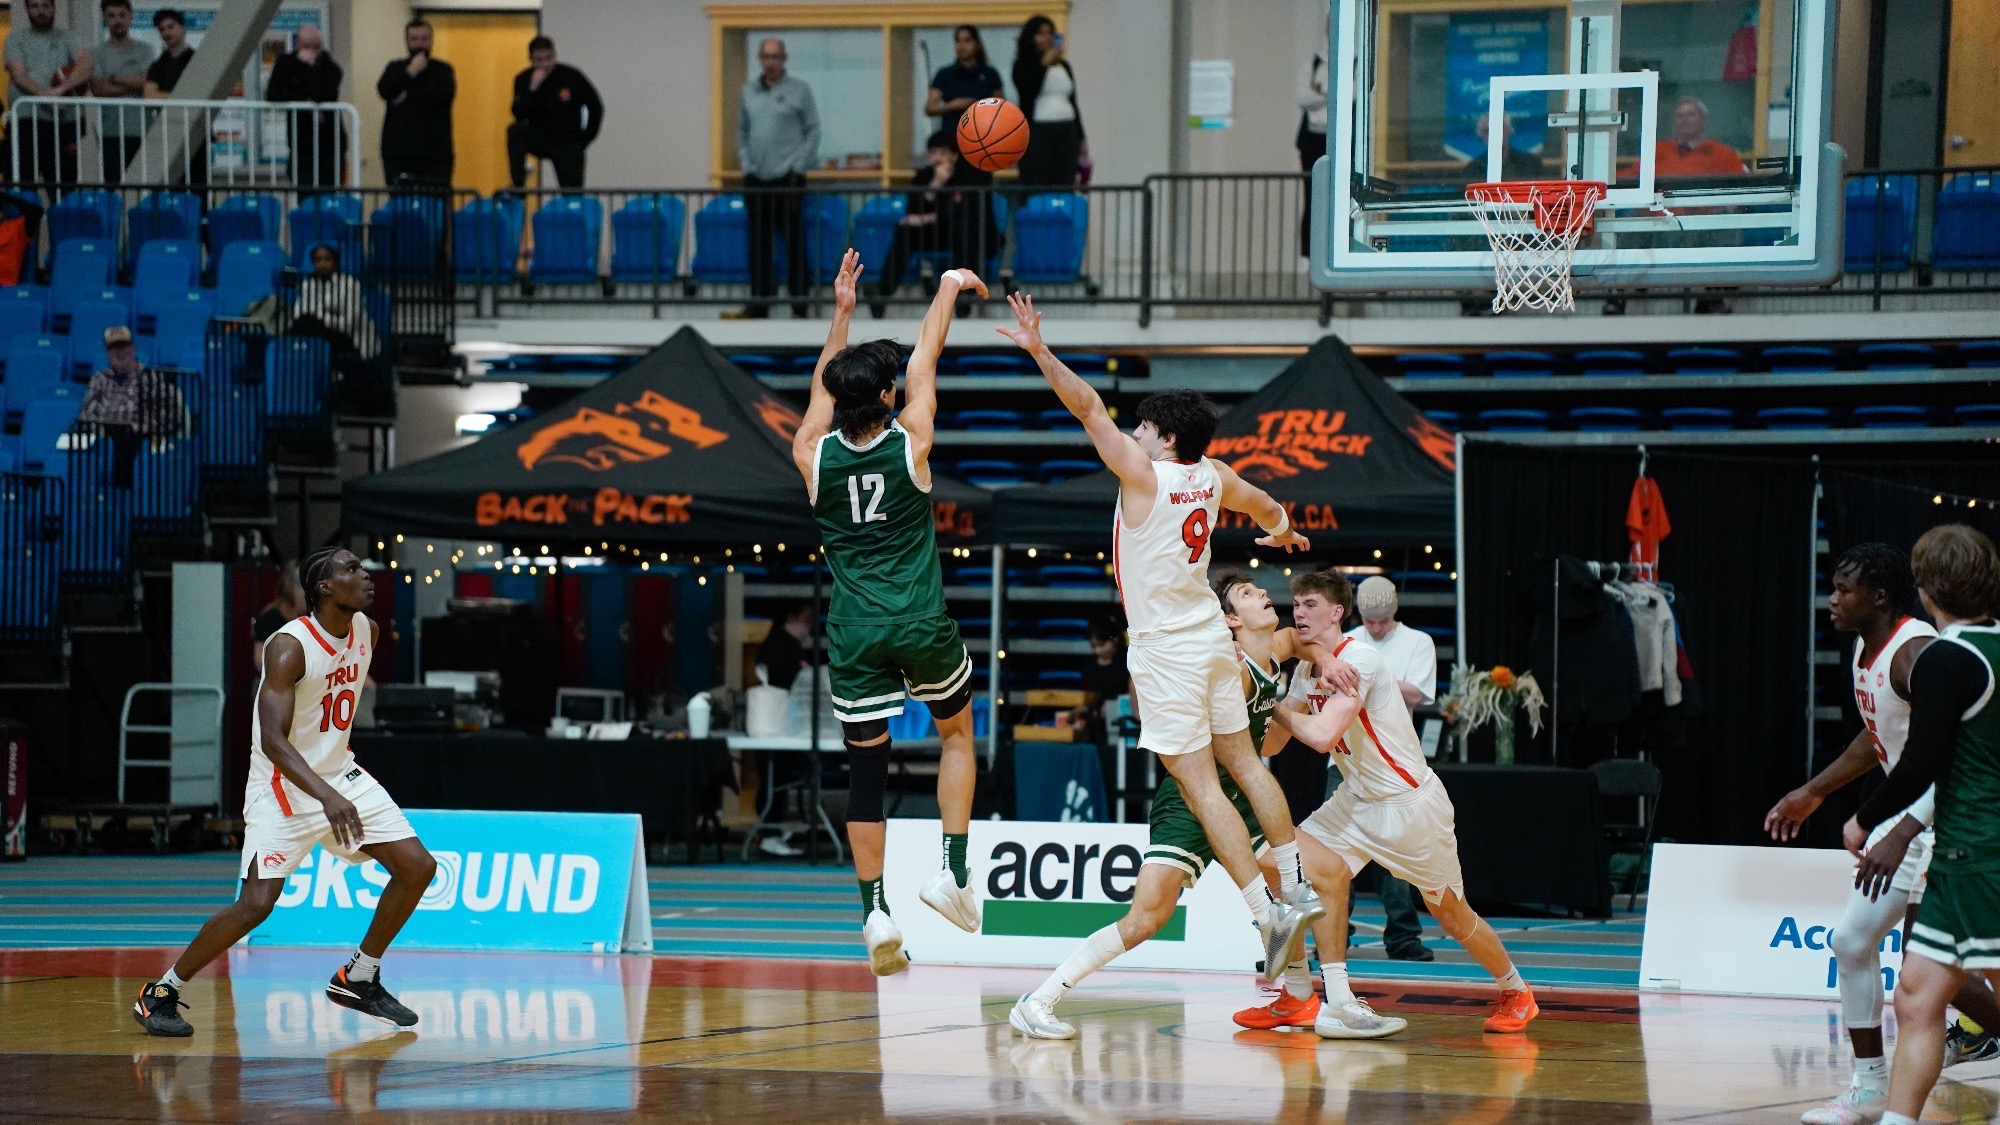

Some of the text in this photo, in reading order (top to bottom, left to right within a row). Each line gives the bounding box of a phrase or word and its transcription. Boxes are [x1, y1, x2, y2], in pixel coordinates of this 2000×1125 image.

[1257, 408, 1347, 435] TRU
[1205, 433, 1373, 457] WOLFPACK
[475, 491, 569, 526] BACK
[593, 486, 693, 526] PACK
[847, 473, 887, 523] 12
[1182, 508, 1210, 564] 9
[325, 663, 359, 691] TRU
[319, 689, 355, 733] 10
[1306, 694, 1330, 713] TR
[987, 841, 1185, 903] acre
